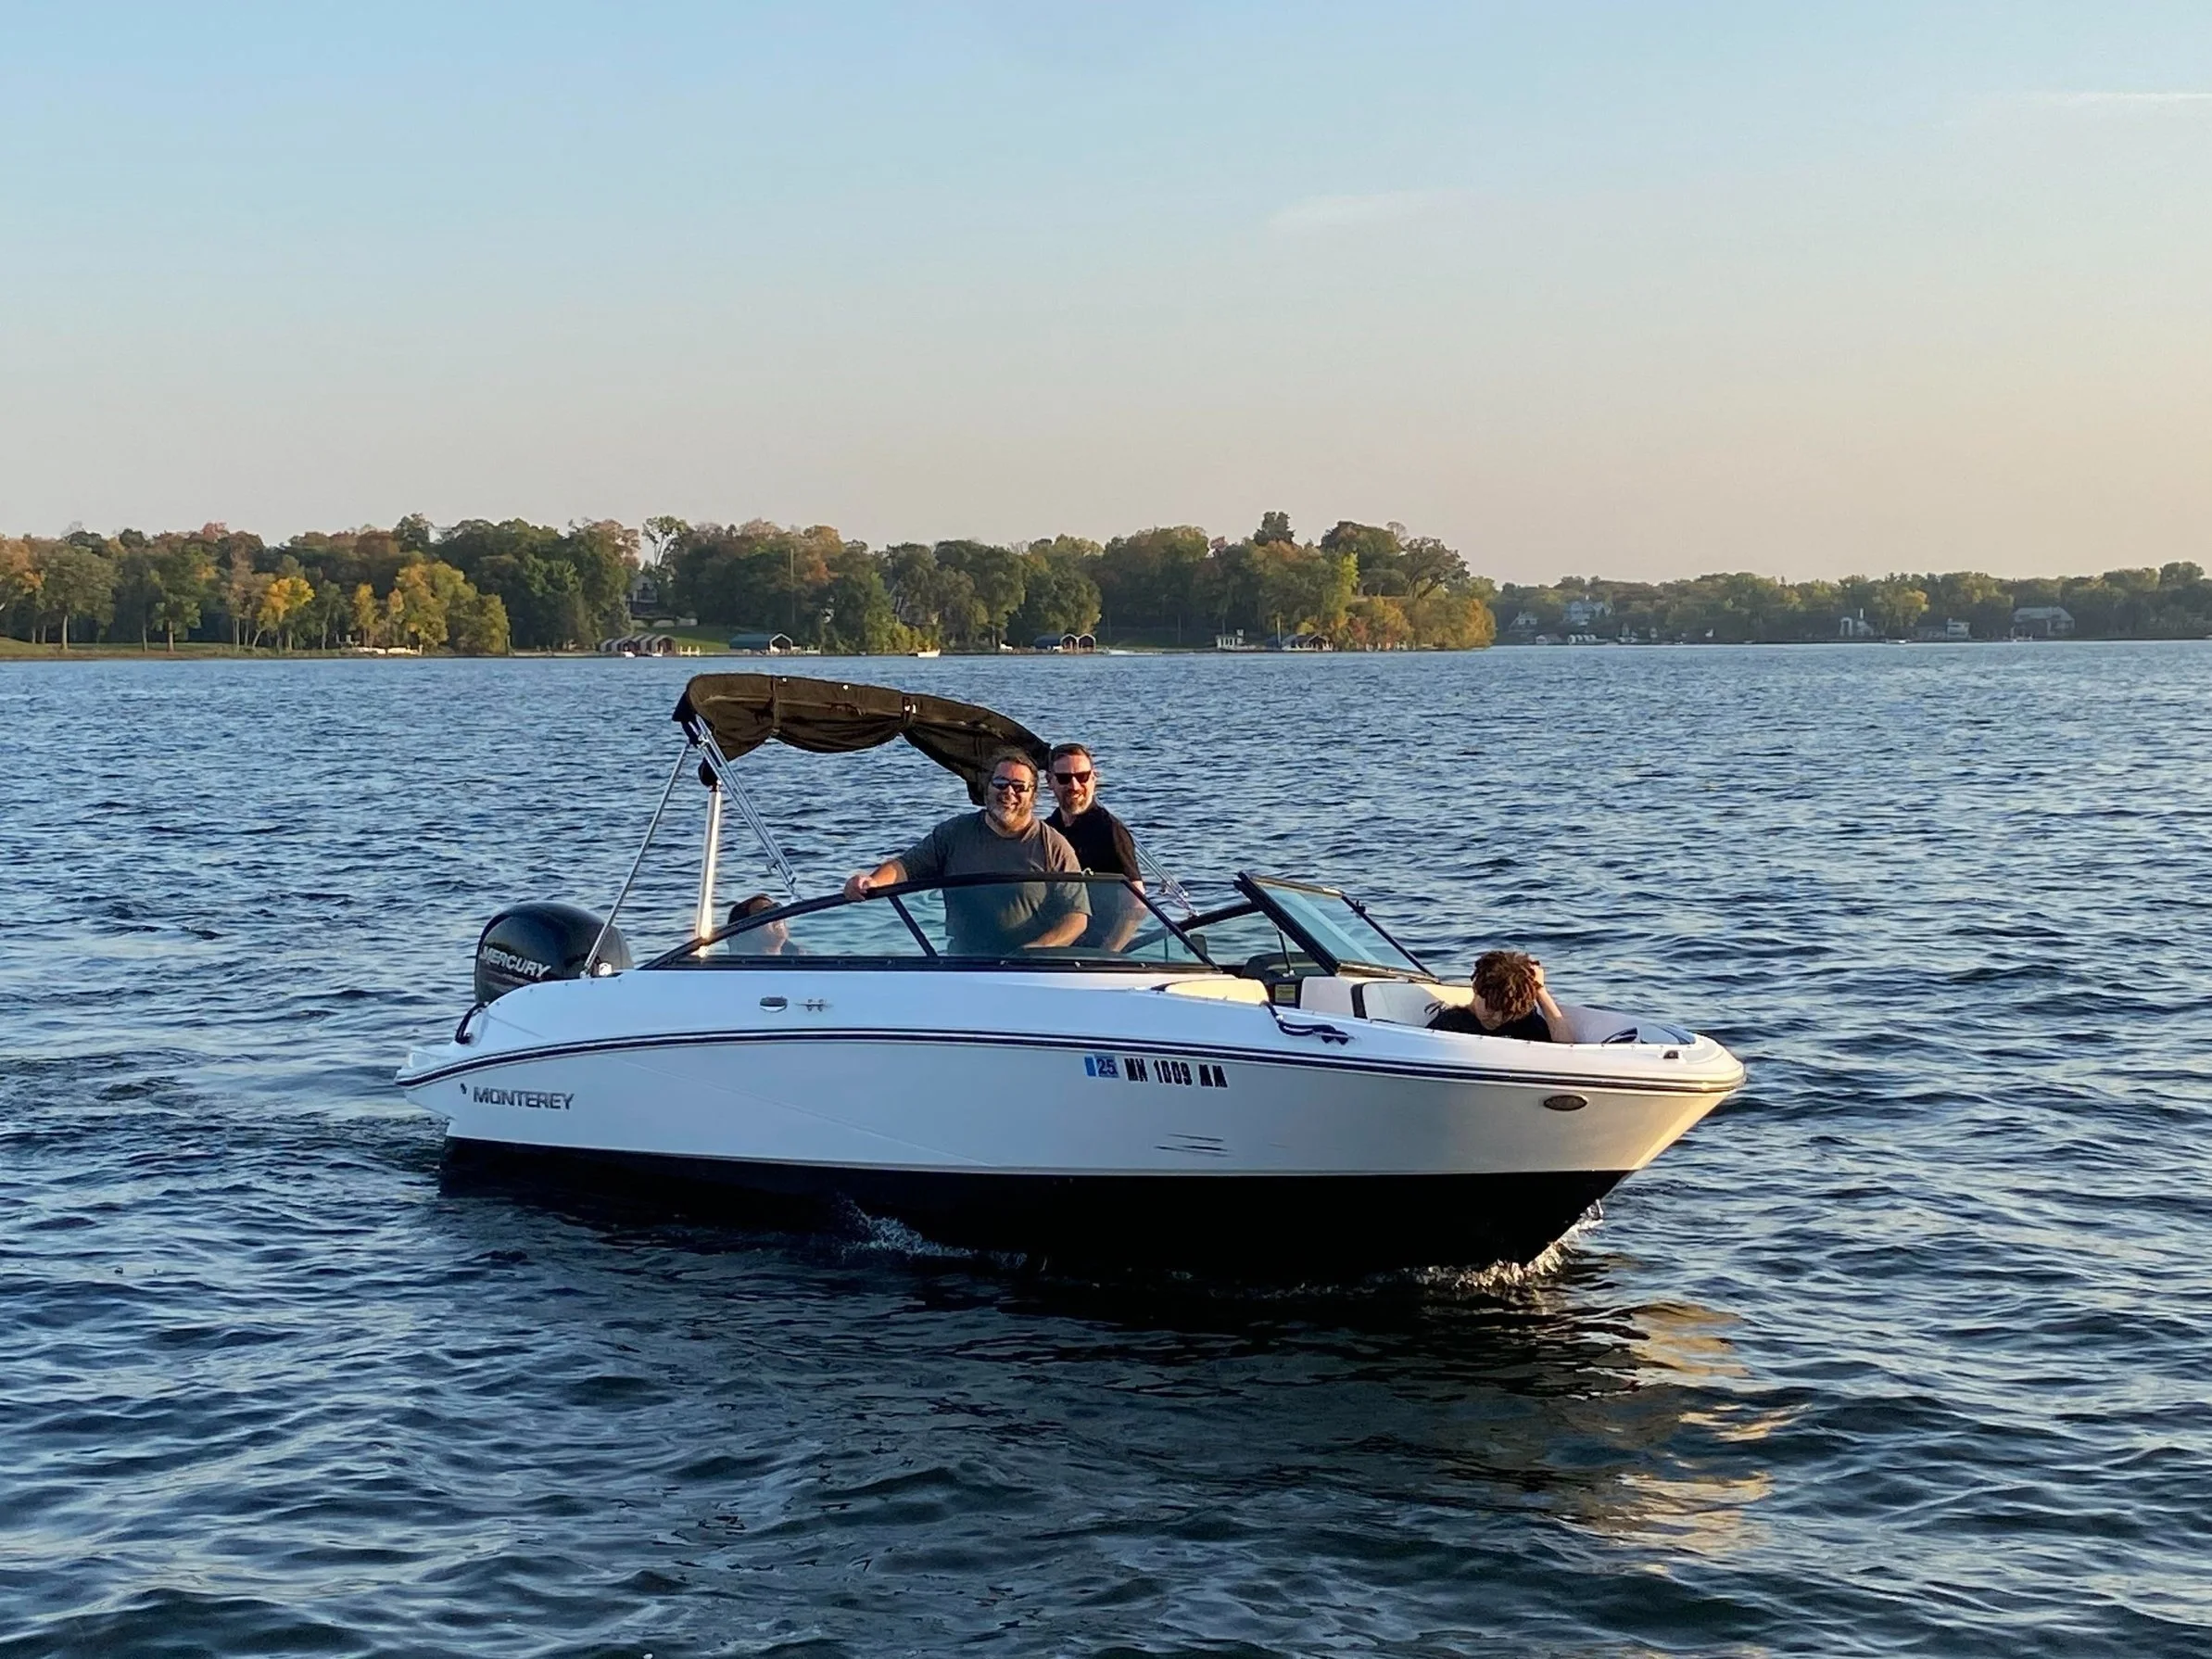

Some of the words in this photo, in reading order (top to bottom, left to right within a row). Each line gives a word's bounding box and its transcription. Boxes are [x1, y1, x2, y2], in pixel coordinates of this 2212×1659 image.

[479, 945, 551, 978] MERCURY
[1096, 1057, 1119, 1076] 25
[1124, 1057, 1148, 1083] MN
[1153, 1059, 1193, 1086] 1009
[473, 1086, 575, 1110] MONTEREY
